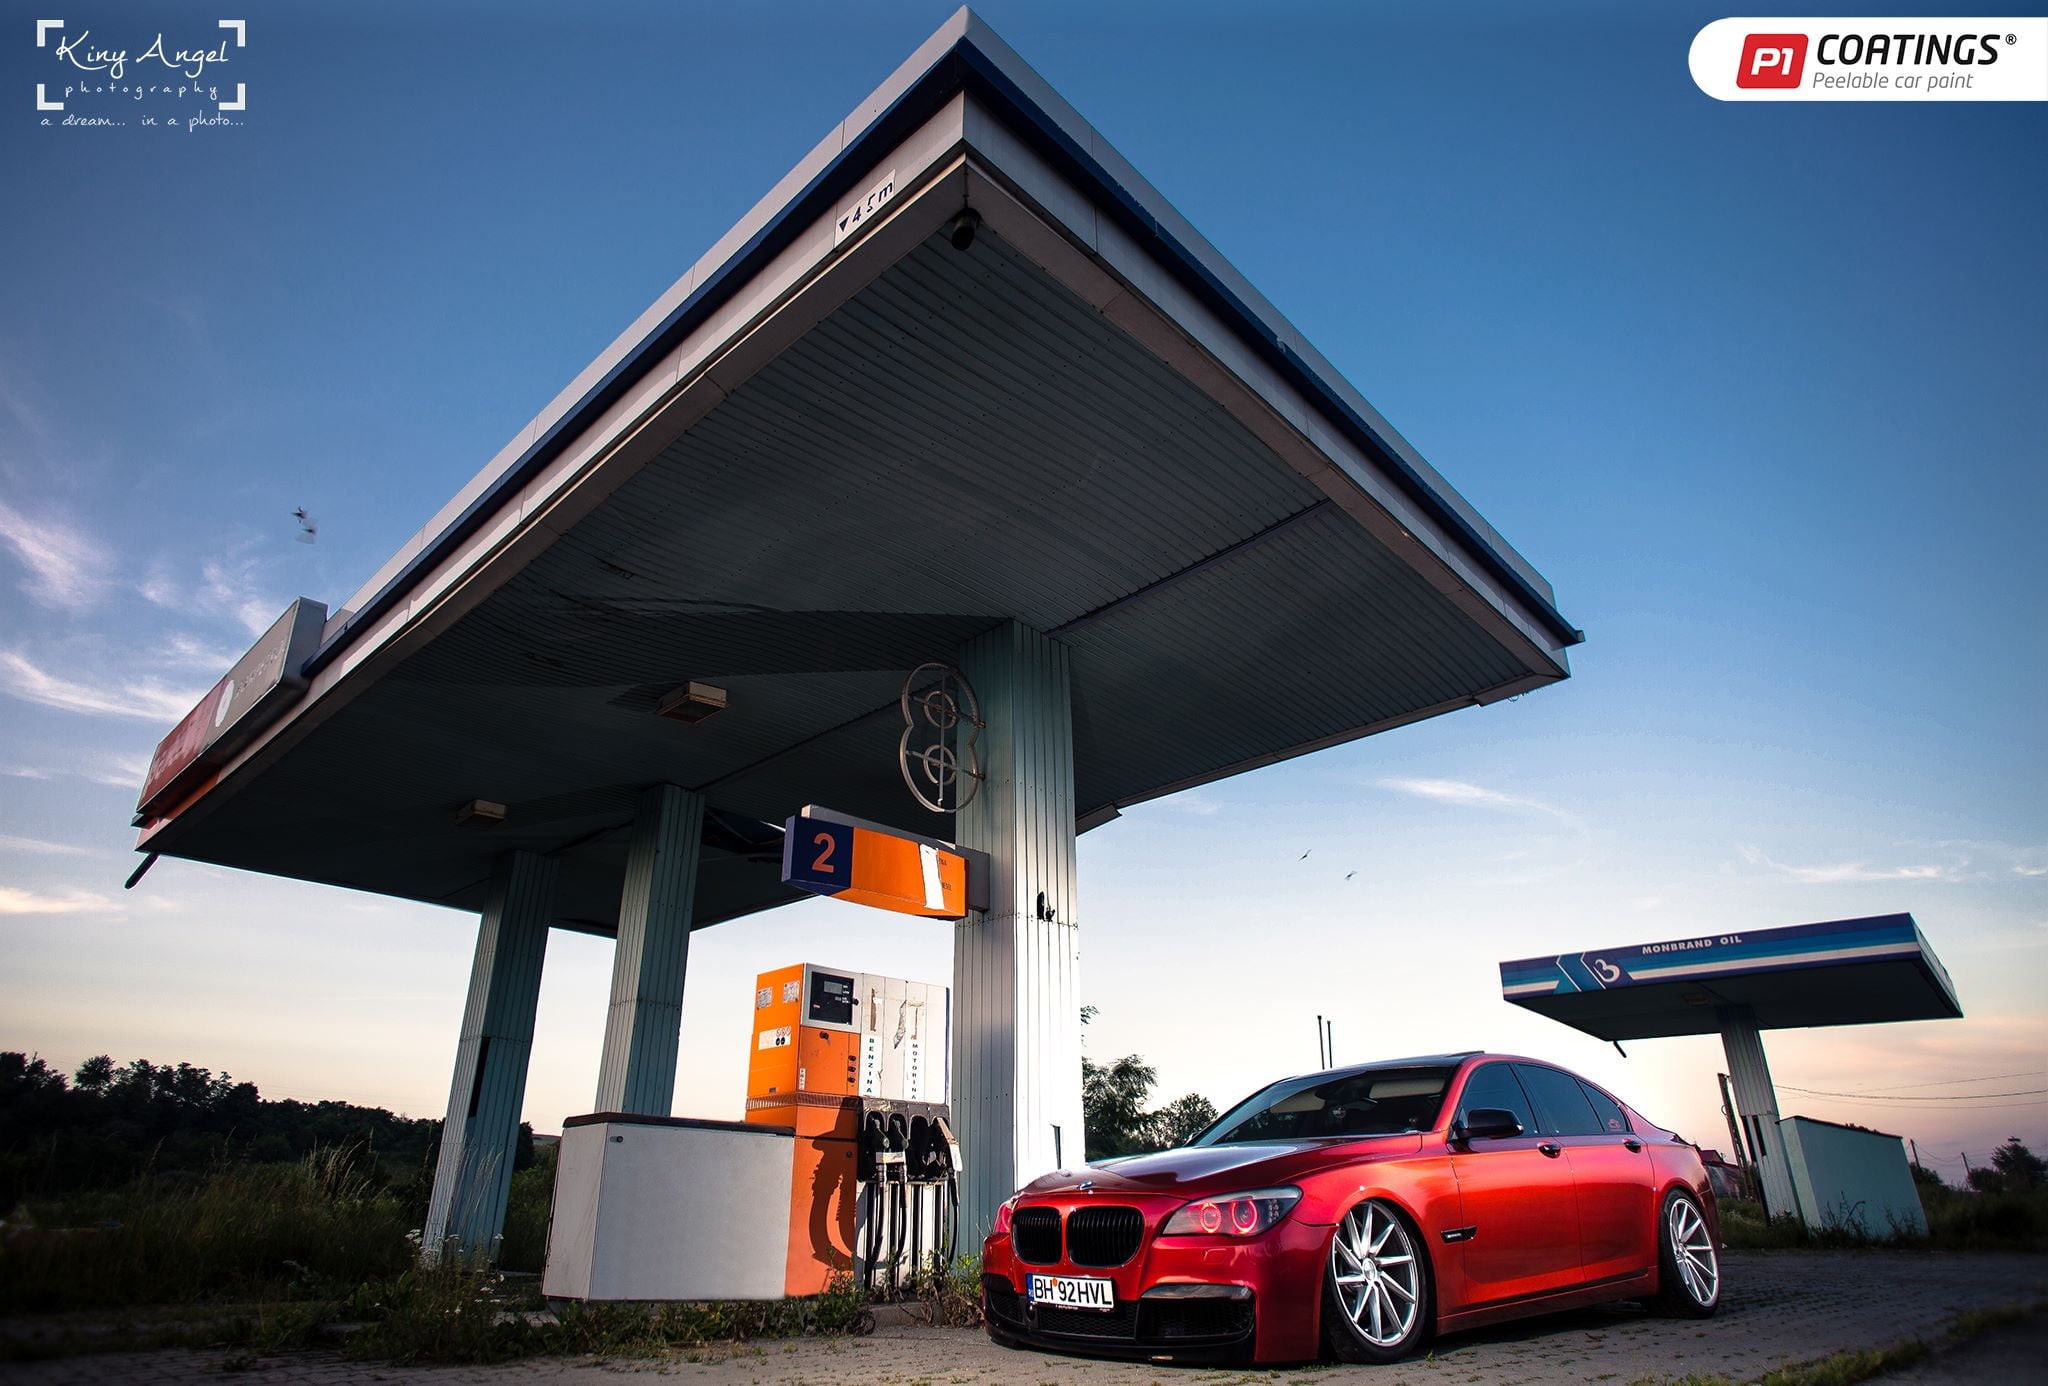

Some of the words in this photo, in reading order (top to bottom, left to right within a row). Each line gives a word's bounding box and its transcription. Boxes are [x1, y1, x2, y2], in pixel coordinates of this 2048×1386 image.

[811, 832, 837, 874] 2
[1641, 937, 1714, 955] MONBRAND
[1719, 934, 1743, 948] OIL
[866, 1037, 875, 1093] BENZINA
